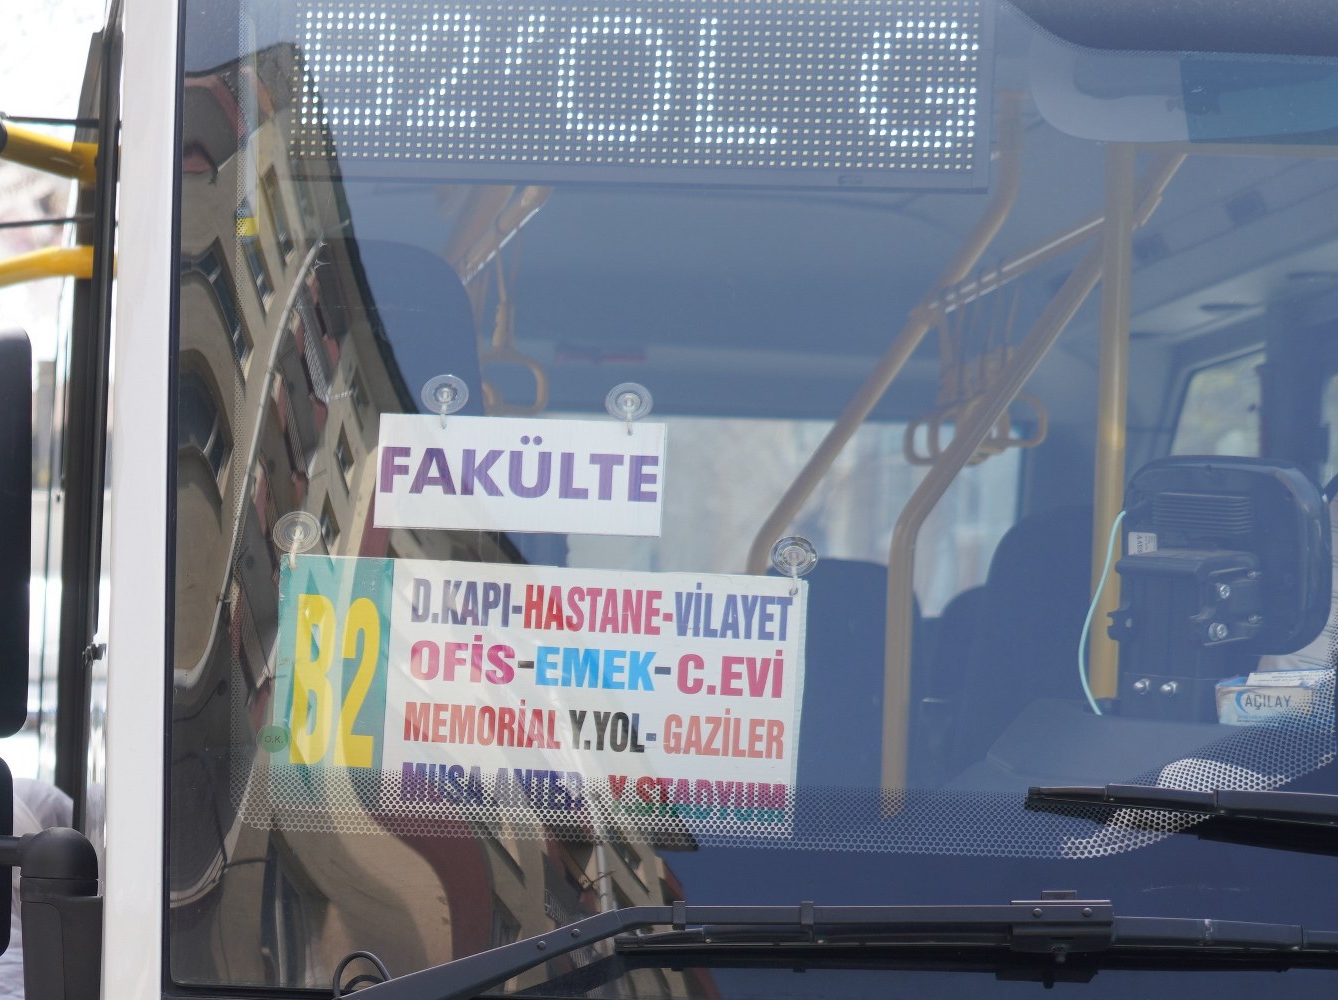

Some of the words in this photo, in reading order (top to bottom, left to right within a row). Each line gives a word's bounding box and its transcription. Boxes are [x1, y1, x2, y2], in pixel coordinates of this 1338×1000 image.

[857, 20, 979, 150] G
[379, 435, 659, 502] FAKÜLTE
[289, 593, 380, 768] B2
[1245, 694, 1292, 710] AÇILAY
[403, 699, 561, 750] MEMORİAL
[664, 708, 785, 760] GAZİLER
